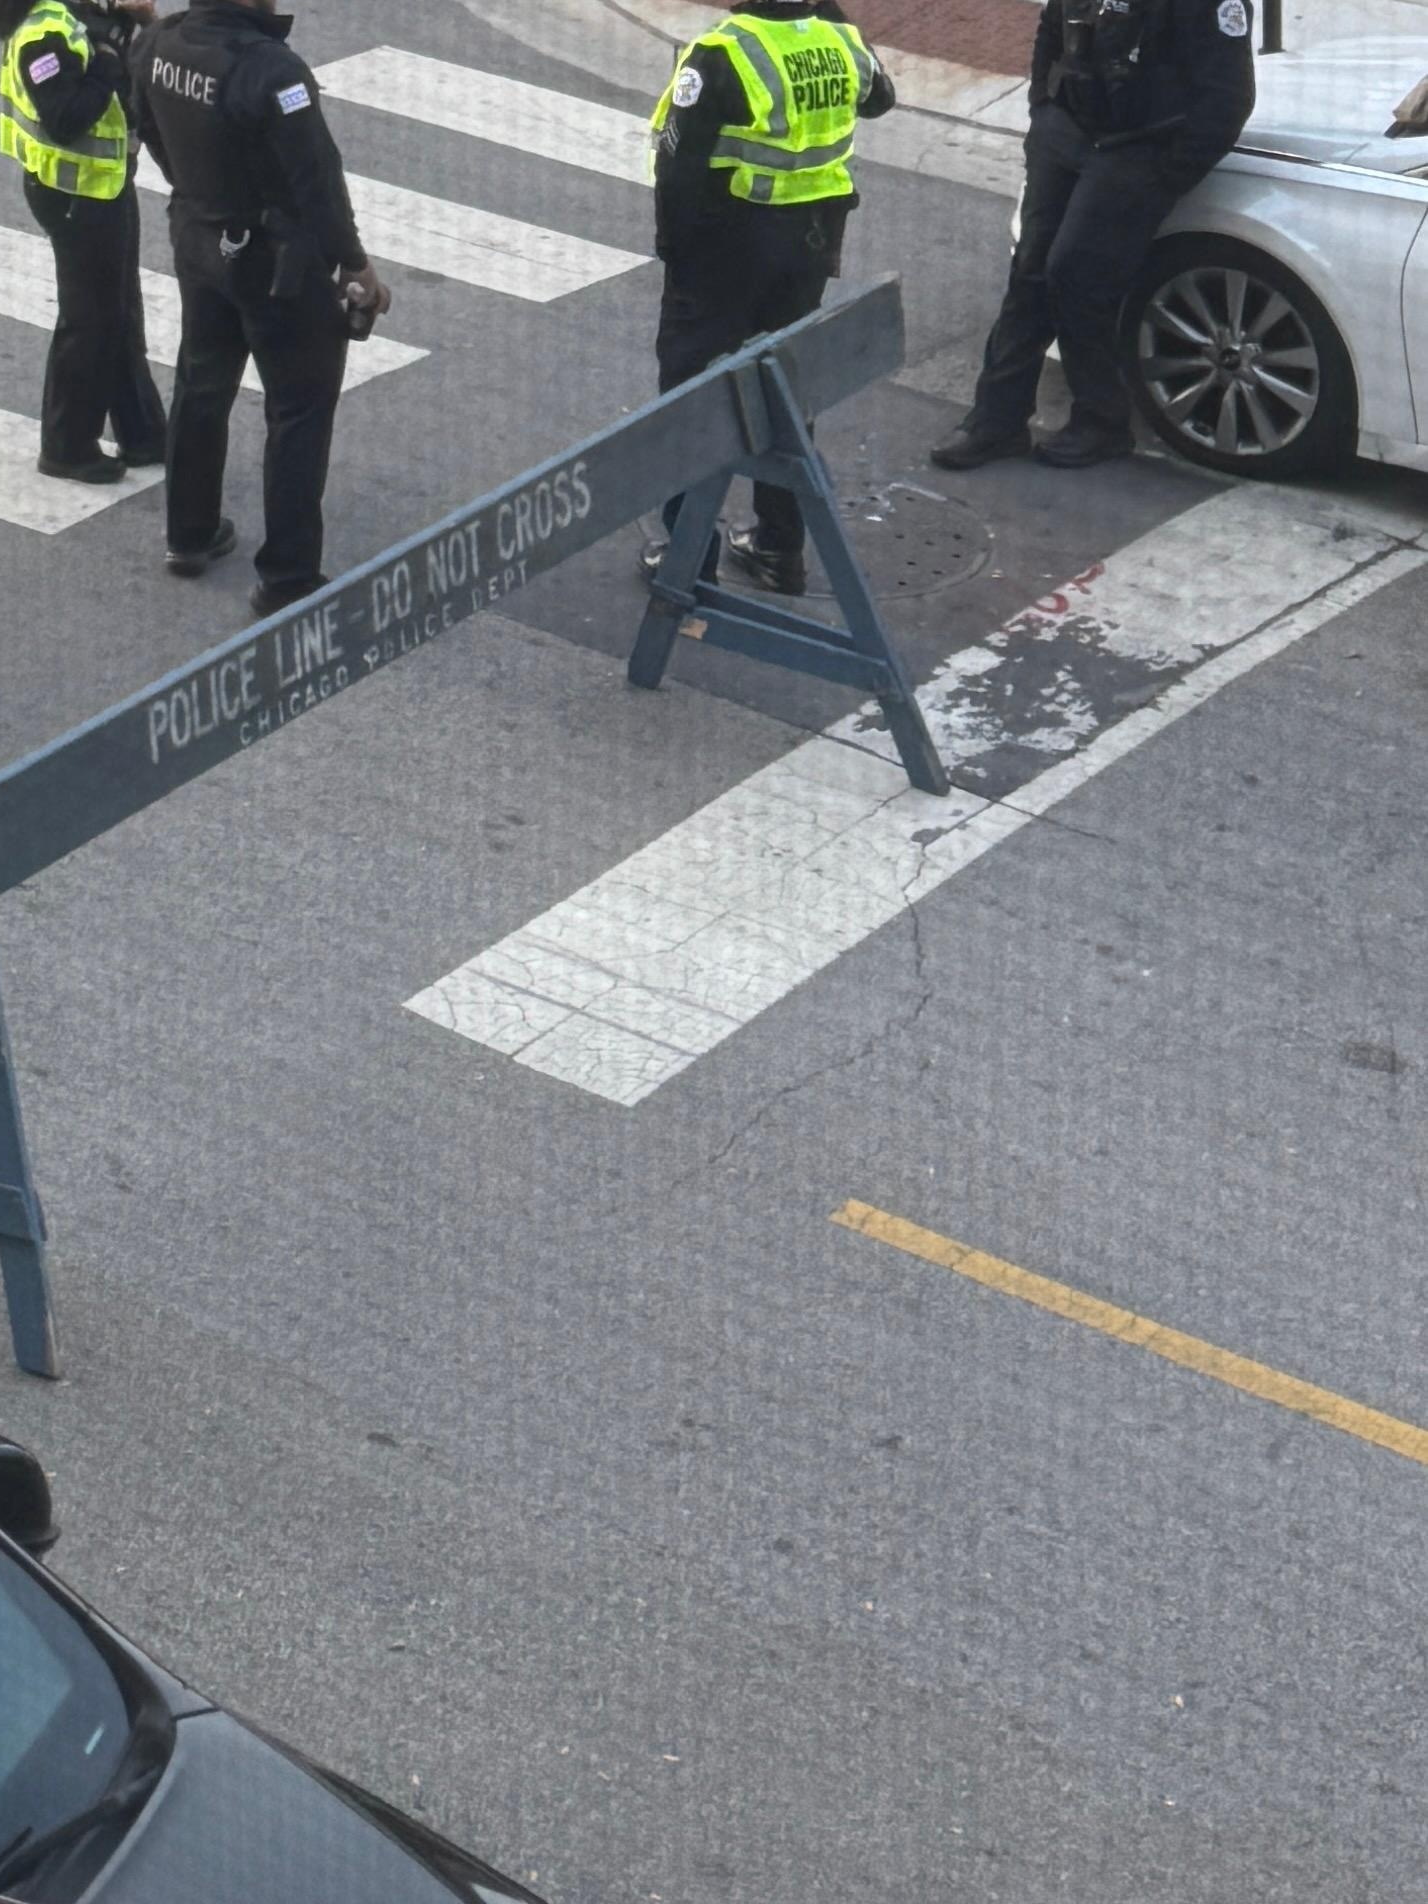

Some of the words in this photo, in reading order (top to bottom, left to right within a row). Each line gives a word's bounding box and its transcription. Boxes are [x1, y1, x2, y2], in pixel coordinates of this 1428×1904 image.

[151, 56, 218, 106] POLICE
[782, 47, 849, 83] CHICAGO
[794, 77, 852, 115] POLICE
[148, 645, 262, 766] POLICE
[274, 599, 344, 687] LINE
[371, 561, 413, 634] DO
[425, 520, 481, 596] NOT
[496, 460, 593, 561] CROSS
[239, 664, 350, 748] CHICAGO
[362, 602, 454, 673] POLICE
[471, 559, 530, 611] DEPT
